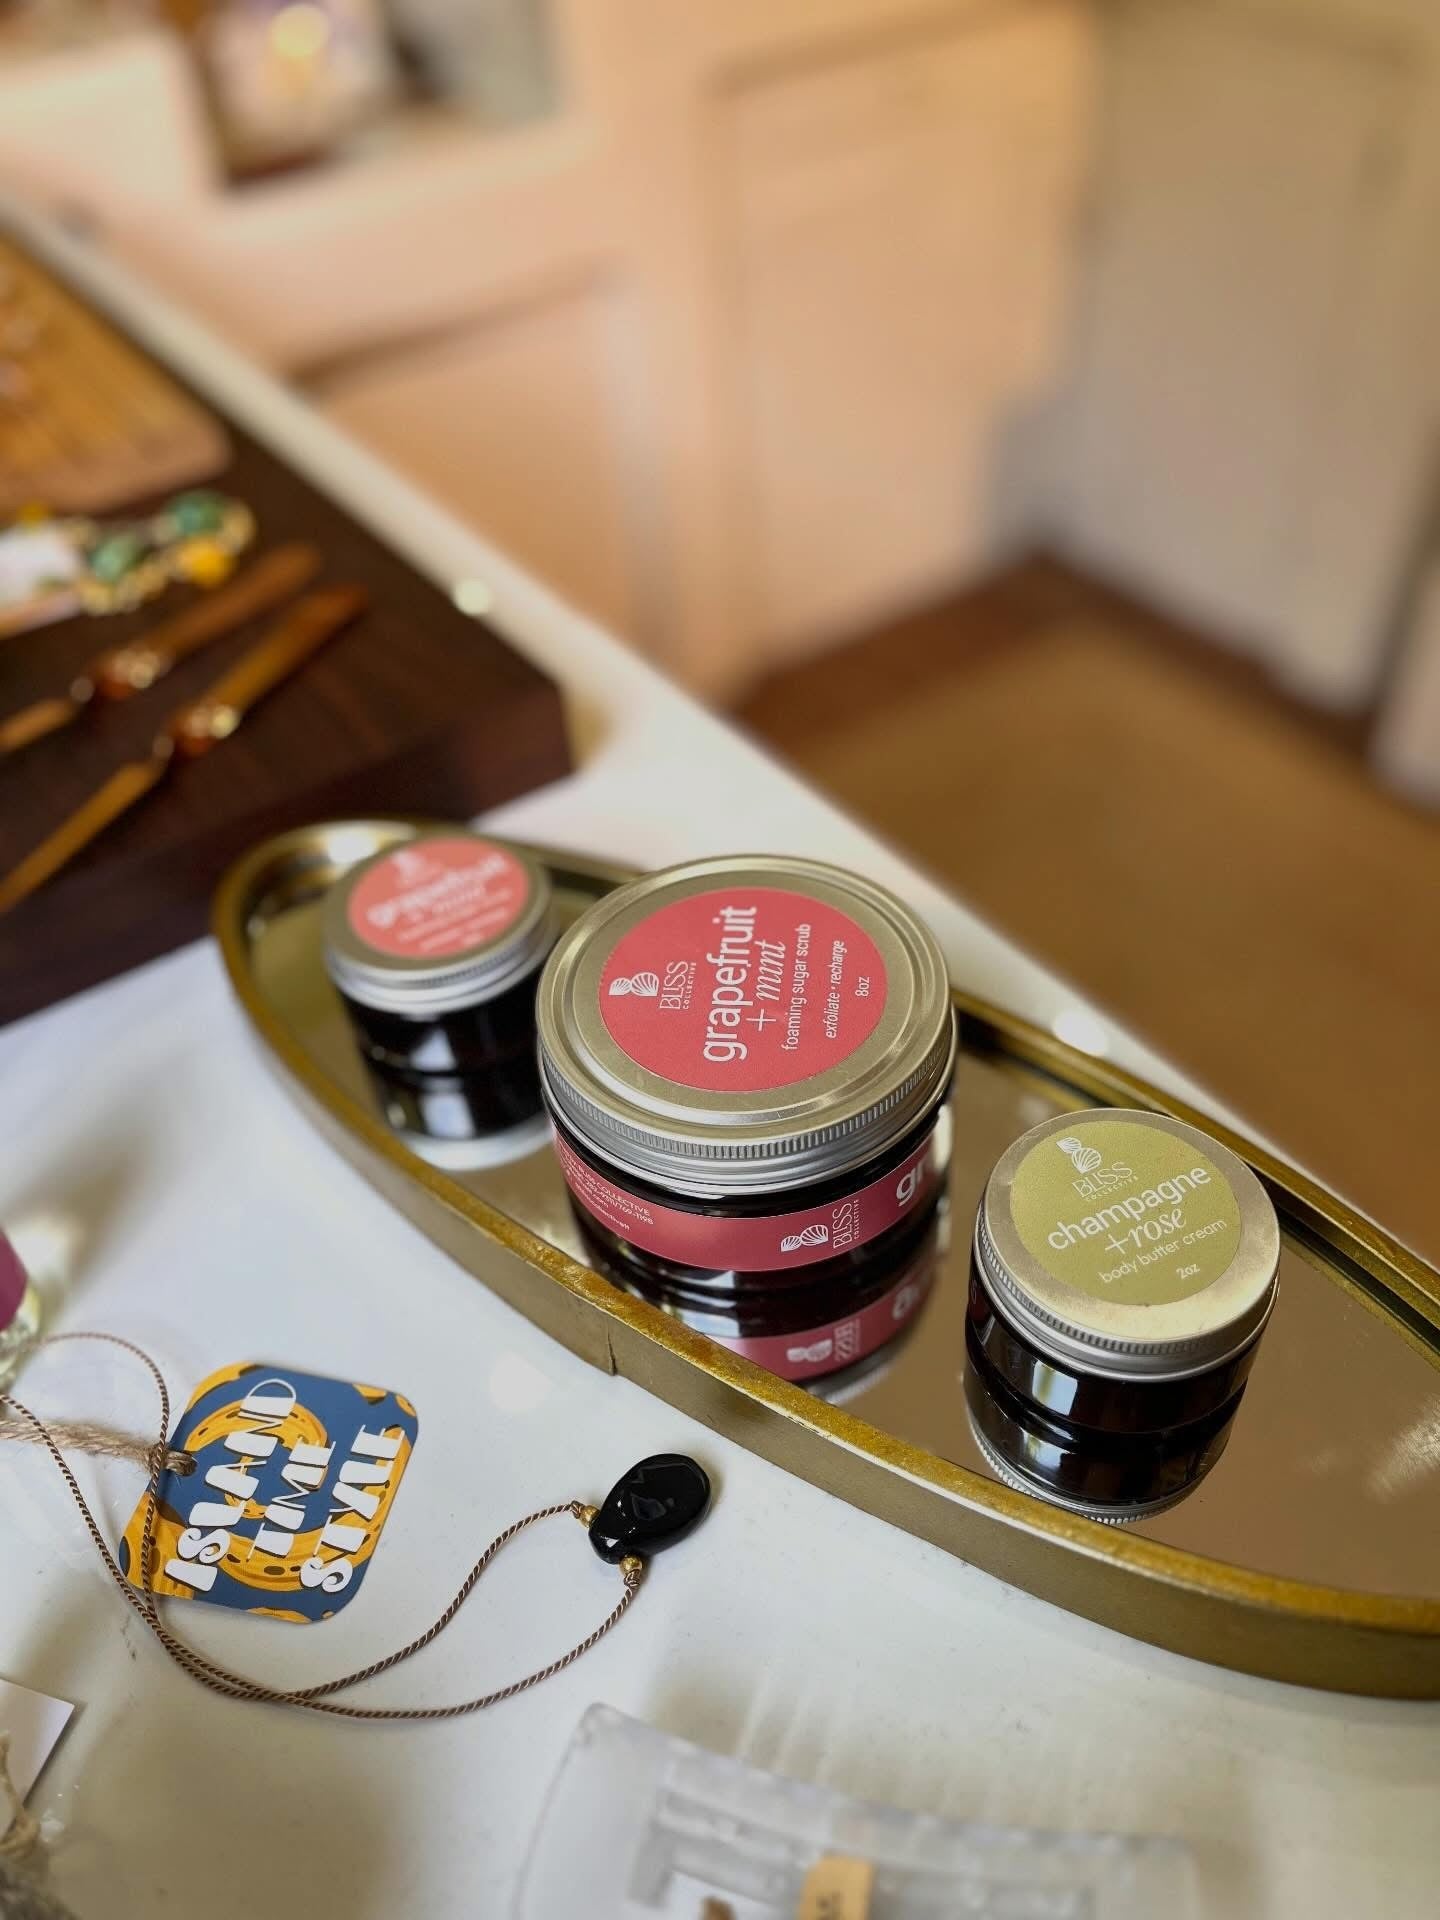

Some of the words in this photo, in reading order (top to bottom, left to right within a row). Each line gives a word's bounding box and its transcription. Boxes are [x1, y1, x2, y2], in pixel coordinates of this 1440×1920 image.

[795, 924, 812, 957] scrub
[826, 940, 848, 985] recharge
[659, 961, 689, 1010] BLISS
[682, 961, 697, 1010] COLLECTIVE
[703, 906, 757, 1062] grapefruit
[753, 939, 786, 1001] mint
[792, 959, 810, 994] sugar
[855, 976, 870, 997] 8oz
[781, 997, 807, 1050] foaming
[822, 992, 841, 1039] exfoliate
[596, 1182, 651, 1217] COLLECTIVE
[1072, 1162, 1133, 1197] BLISS
[832, 1203, 853, 1249] BLISS
[853, 1199, 861, 1240] COLLECTIVE
[1047, 1167, 1212, 1250] champagne
[1097, 1260, 1138, 1284] body
[1137, 1240, 1180, 1266] butter
[1182, 1219, 1228, 1246] cream
[1176, 1263, 1200, 1280] 2oz
[165, 1378, 297, 1592] ISLAND
[246, 1435, 337, 1563] TIME
[300, 1424, 405, 1593] STYLE
